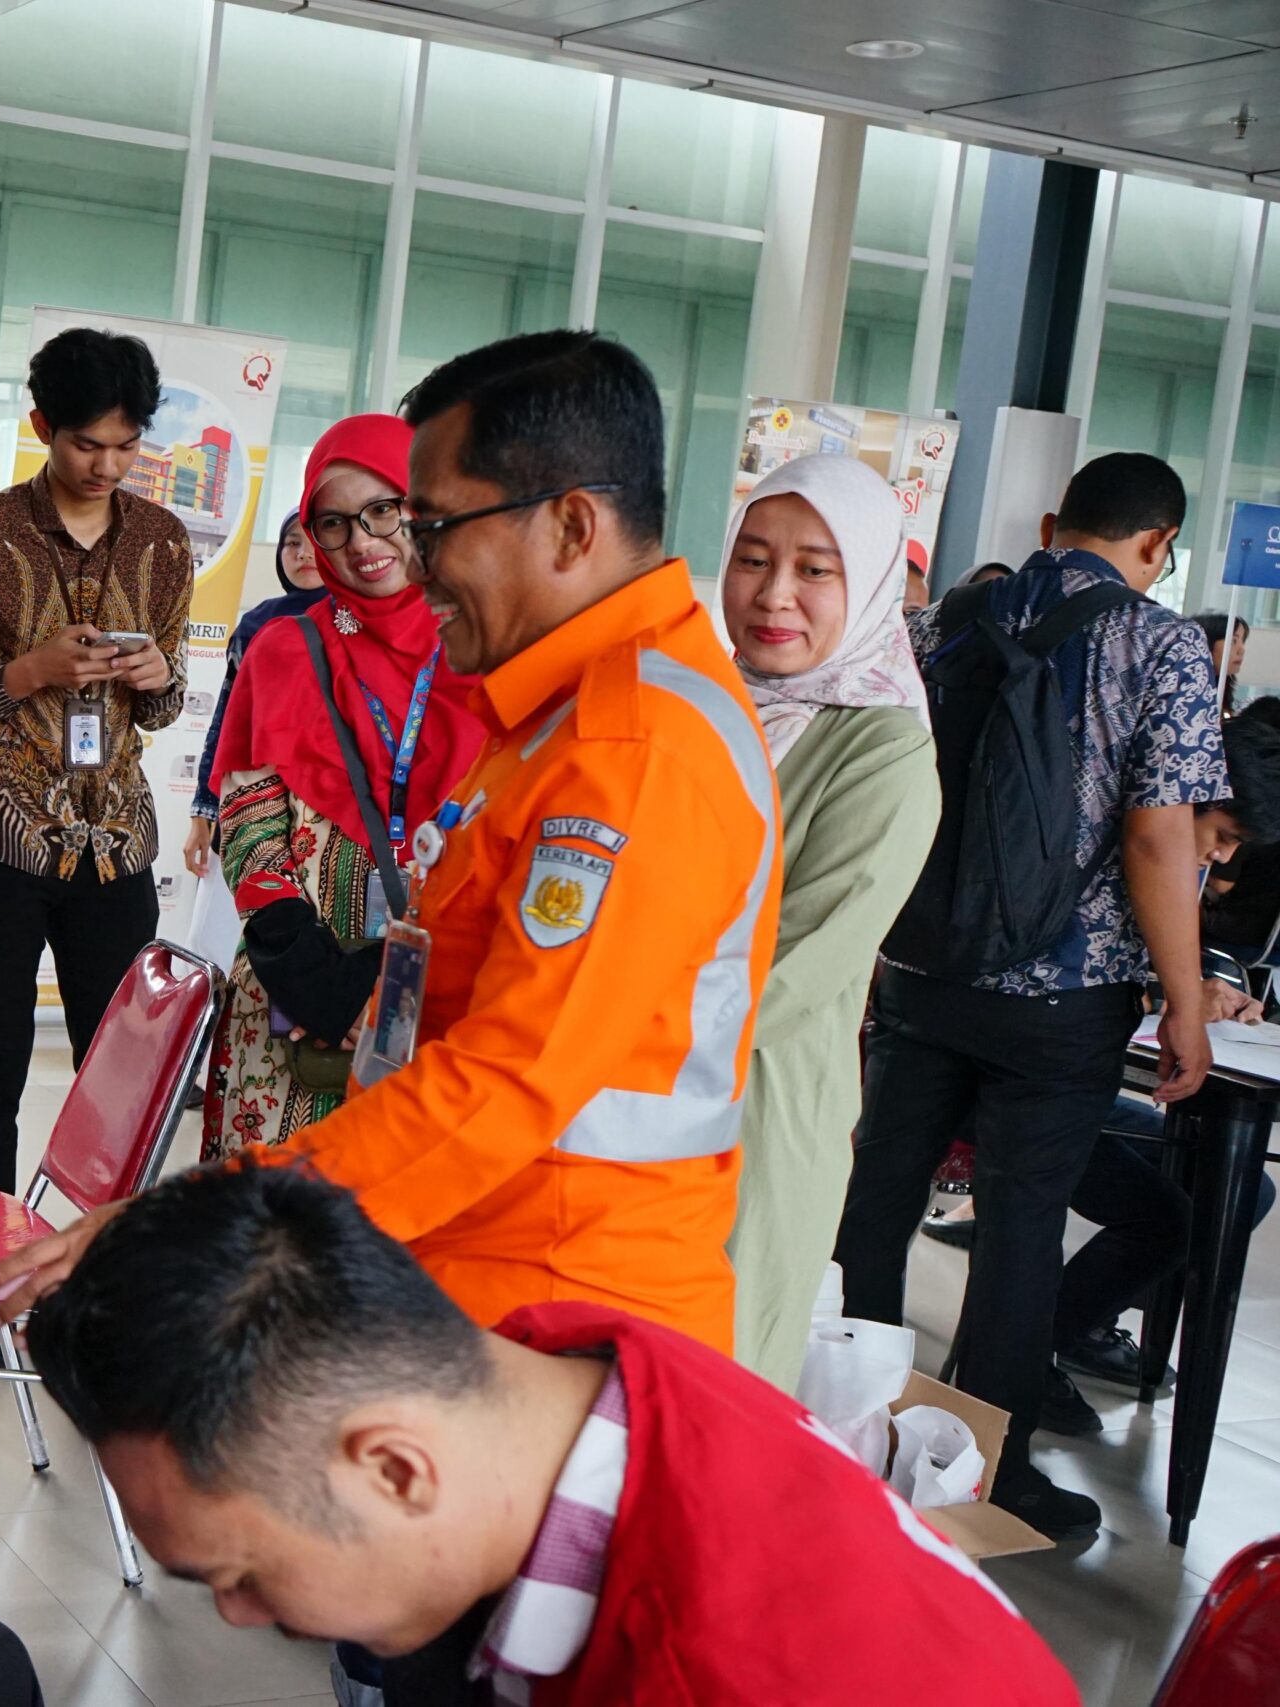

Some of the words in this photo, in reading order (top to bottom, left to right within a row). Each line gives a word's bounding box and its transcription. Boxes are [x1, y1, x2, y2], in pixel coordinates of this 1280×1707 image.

[188, 624, 227, 639] MRIN
[545, 820, 602, 840] DIVRE
[538, 847, 584, 866] KERETA
[587, 858, 610, 874] API
